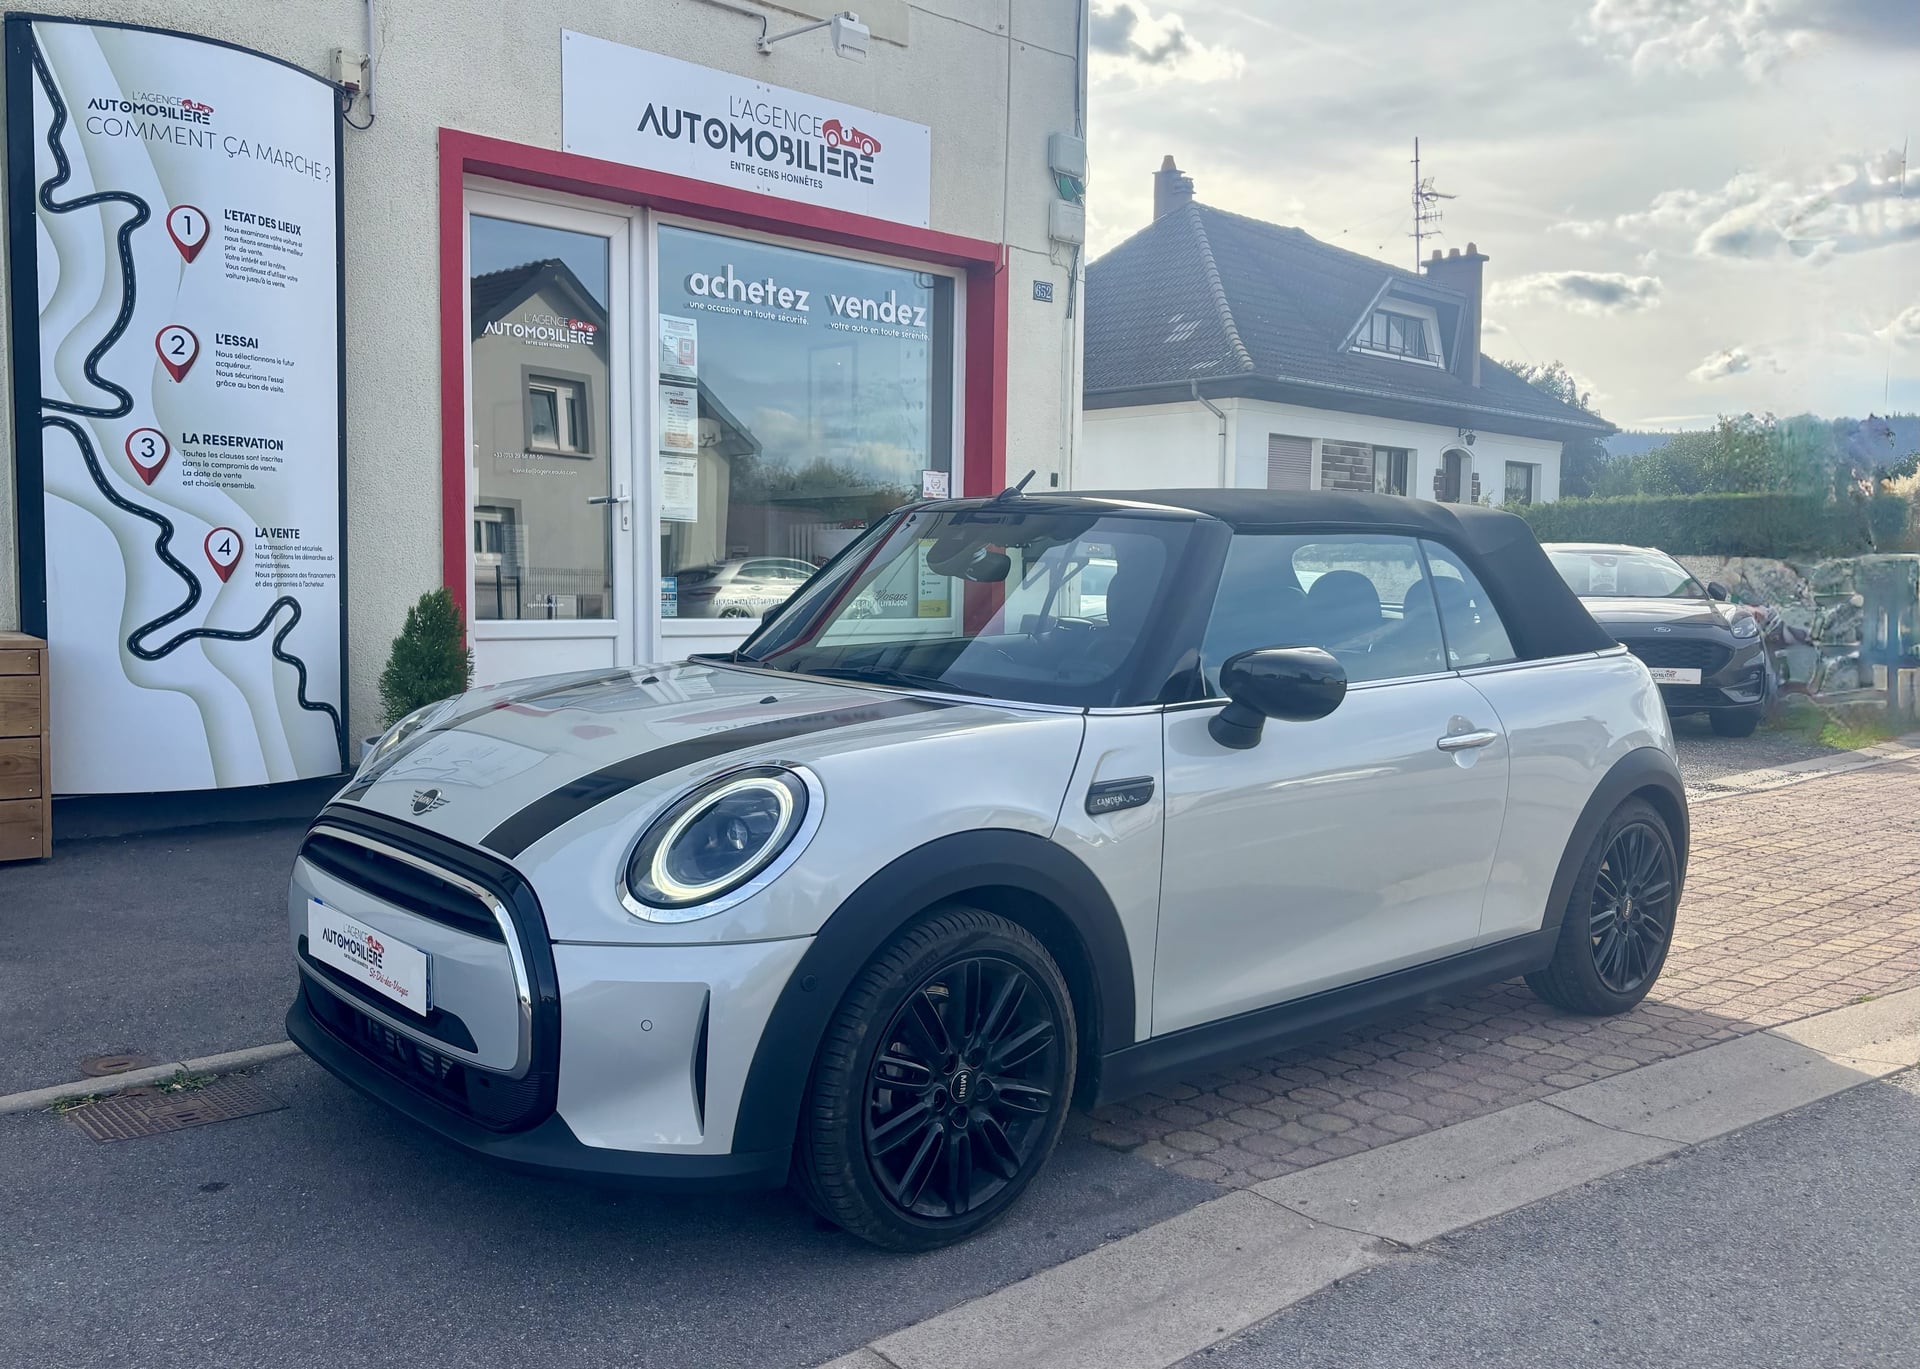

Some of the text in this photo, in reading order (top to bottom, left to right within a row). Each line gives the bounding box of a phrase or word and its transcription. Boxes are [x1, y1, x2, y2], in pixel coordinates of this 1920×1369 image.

[132, 91, 182, 106] L'AGENCE
[729, 96, 822, 138] L'AGENCE
[86, 116, 331, 182] COMMENT ÇA MARCHE ?
[730, 160, 822, 189] ENTRE GENS HONNÊTES
[184, 215, 190, 235] 1
[225, 209, 301, 236] L'ETAT DES LIEUX
[225, 225, 239, 233] Nous
[240, 228, 269, 239] examinons
[240, 237, 256, 246] fixons
[257, 242, 281, 251] ensemble
[241, 256, 258, 264] intérêt
[240, 266, 266, 275] continuez
[689, 264, 809, 311] achetez
[1035, 284, 1051, 298] 652
[689, 301, 809, 325] une occasion en toute sécurité.
[831, 290, 926, 327] vendez
[524, 312, 568, 328] L'AGENCE
[830, 322, 850, 331] votre
[851, 324, 869, 333] auto
[880, 327, 899, 337] toute
[901, 329, 930, 341] sérénité.
[171, 335, 185, 355] 2
[216, 333, 258, 348] L'ESSAI
[216, 361, 252, 370] acquéreur.
[235, 353, 275, 364] sélectionnons
[235, 372, 266, 381] sécurisons
[141, 438, 155, 457] 3
[182, 432, 283, 450] LA RESERVATION
[182, 450, 206, 458] Toutes
[219, 452, 245, 460] clauses
[255, 527, 300, 539] LA VENTE
[218, 537, 231, 555] 4
[1097, 795, 1124, 807] CAMDEN
[959, 1074, 967, 1097] MINI
